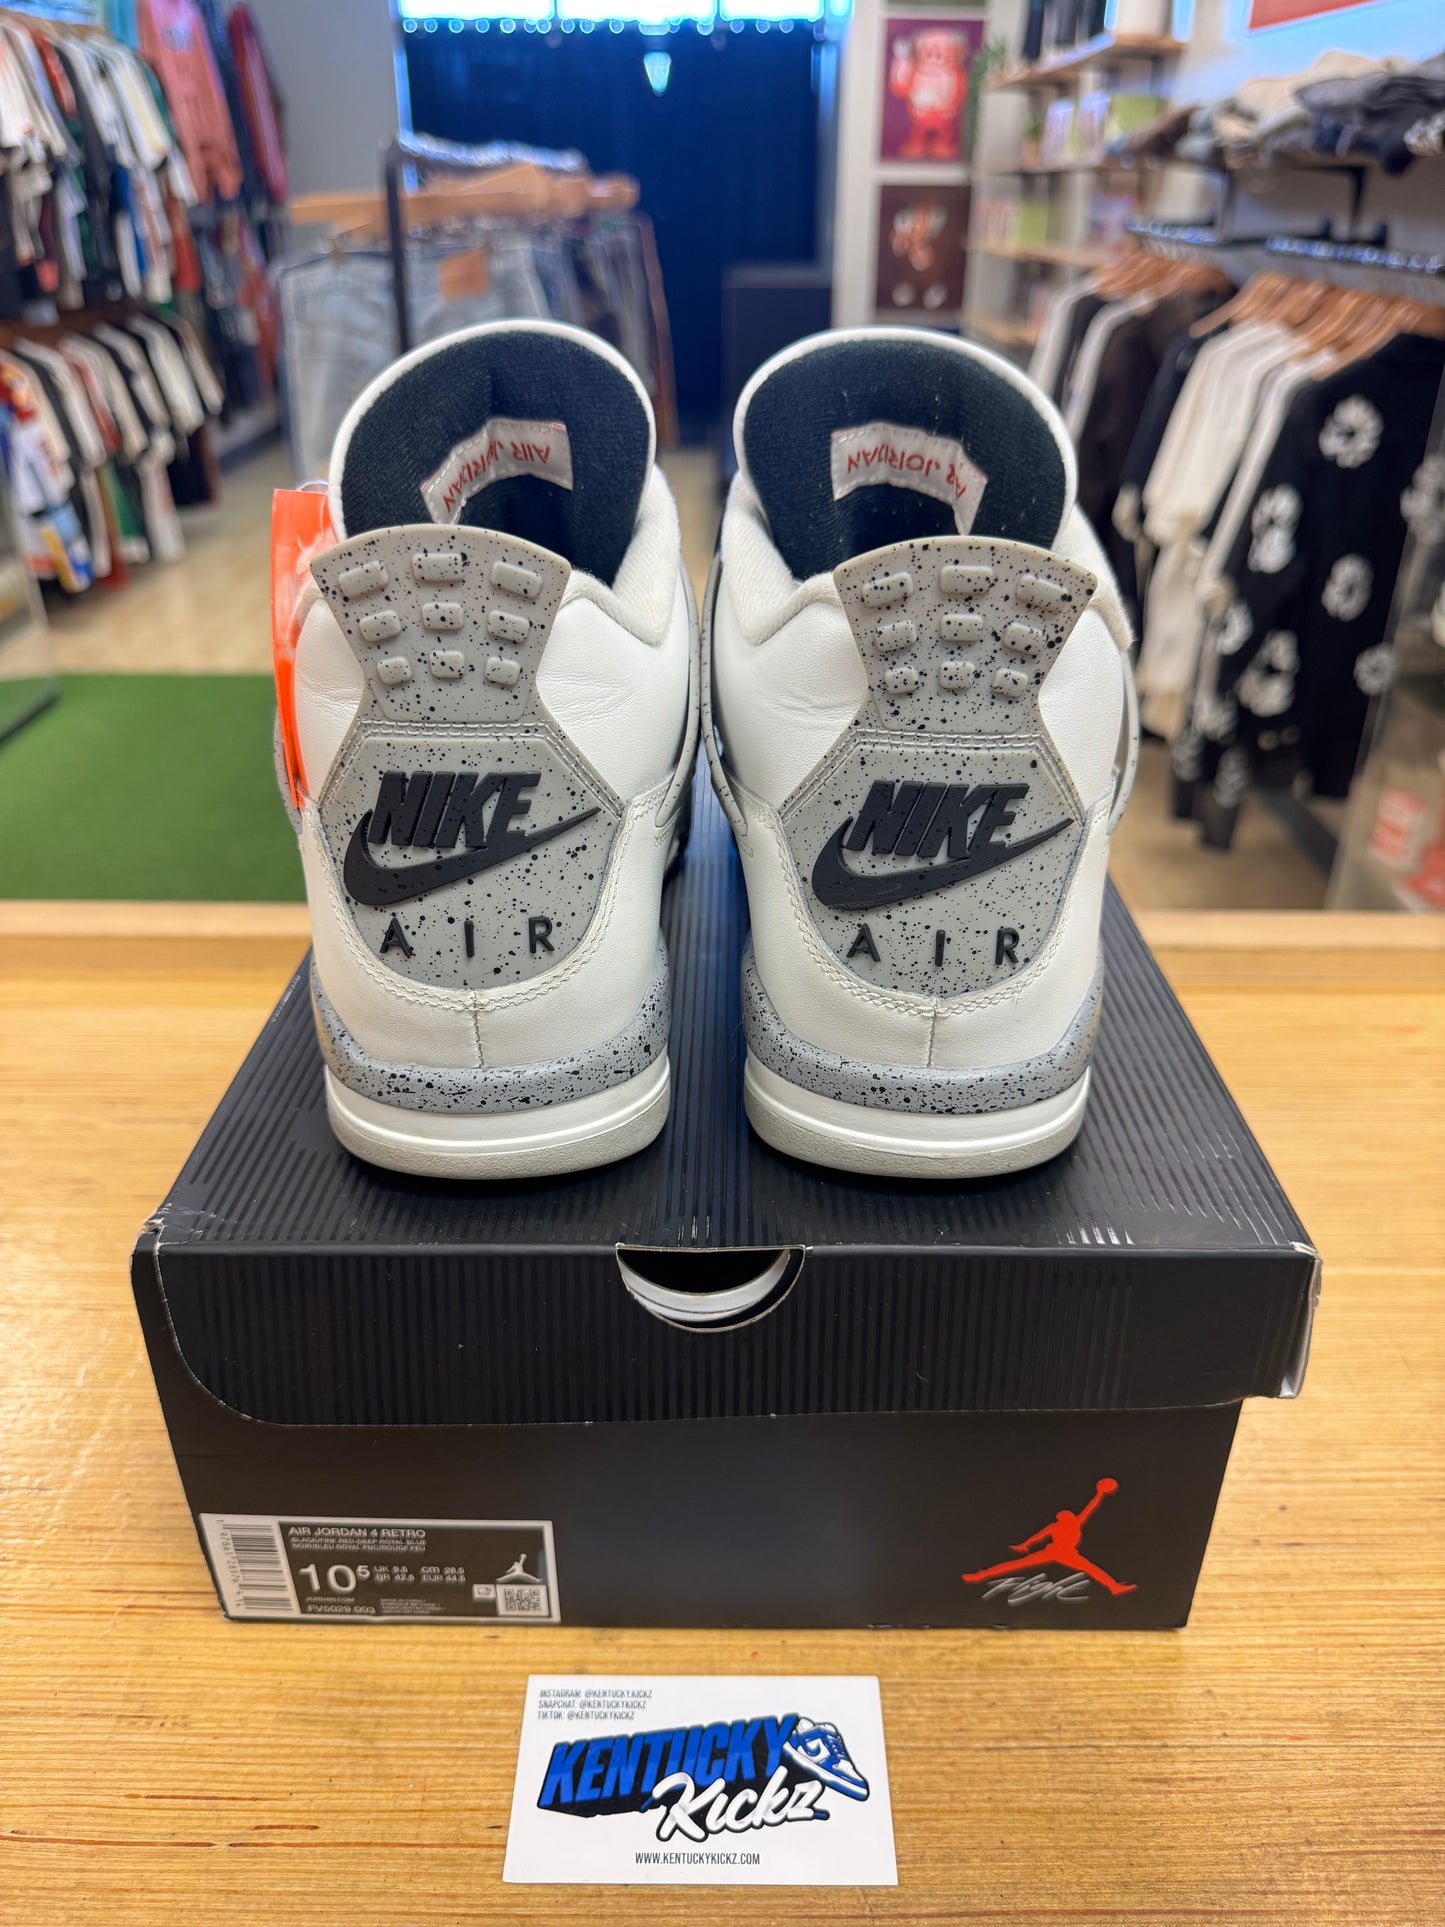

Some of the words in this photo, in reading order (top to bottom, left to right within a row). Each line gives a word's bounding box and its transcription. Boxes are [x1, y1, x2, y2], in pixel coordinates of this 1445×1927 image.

[510, 441, 552, 464] AIR
[847, 443, 940, 477] JORDAN
[367, 771, 542, 849] NIKE
[843, 779, 1030, 858] NIKE
[379, 916, 555, 958] AIR
[846, 922, 1020, 967] AIR
[288, 1526, 312, 1536] AIR
[314, 1527, 368, 1537] JORDAN
[369, 1528, 379, 1537] 4
[381, 1529, 426, 1538] RETRO
[538, 1699, 576, 1709] SNAPCHAT:
[540, 1688, 582, 1699] INSTAGRAM:
[537, 1710, 565, 1720] TIKTOK:
[538, 1713, 799, 1808] KENTUCKY
[651, 1766, 826, 1841] Kickz
[635, 1852, 760, 1866] WWW.KENTUCKYKICKZ.COM
